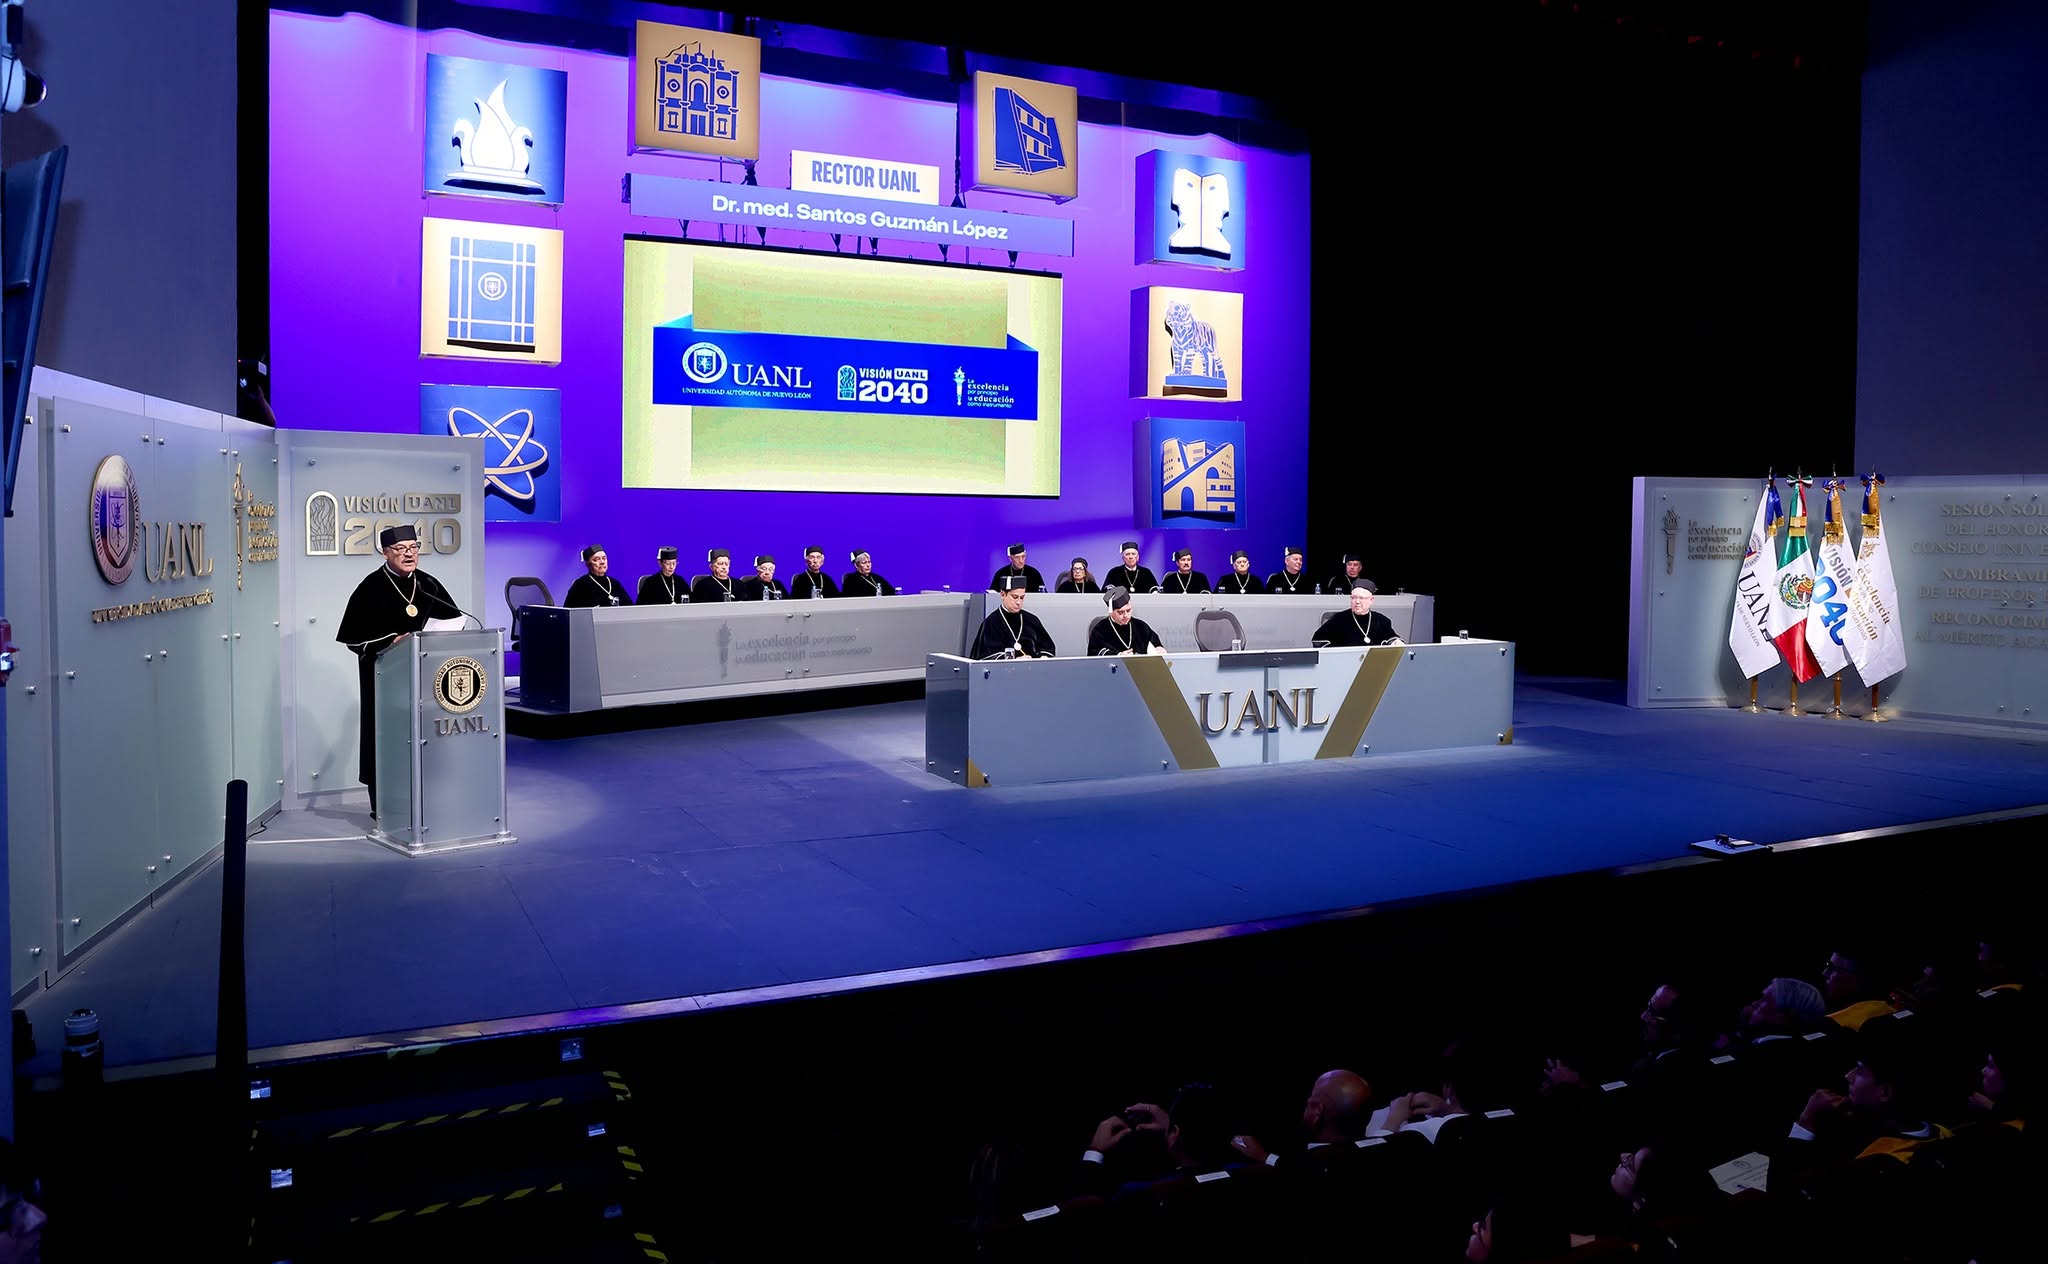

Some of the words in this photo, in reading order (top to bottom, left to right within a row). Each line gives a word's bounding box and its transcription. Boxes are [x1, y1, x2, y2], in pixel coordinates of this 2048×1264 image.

[812, 160, 874, 188] RECTOR
[878, 168, 921, 193] UANL
[712, 194, 740, 214] Dr.
[743, 201, 793, 219] med.
[796, 203, 867, 225] Santos
[870, 211, 949, 233] Guzmán
[952, 219, 1009, 240] López
[731, 363, 812, 388] UANL
[859, 367, 892, 379] VISIÓN
[895, 369, 927, 380] UANL
[682, 387, 725, 396] UNIVERSIDAD
[725, 388, 762, 398] AUTÓNOMA
[794, 391, 812, 399] LEÓN
[859, 380, 928, 404] 2040
[967, 383, 1010, 391] excelencia
[974, 395, 1015, 403] educación
[343, 492, 399, 513] VISIÓN
[408, 495, 459, 511] UANL
[1688, 525, 1742, 535] excelencia
[1944, 522, 1975, 536] DEL
[141, 521, 215, 583] UANL
[1911, 542, 1988, 554] CONSEJO
[1823, 544, 1853, 589] VISIÓN
[1857, 567, 1891, 624] excelencia
[1945, 586, 2037, 601] PROFESOR
[747, 632, 810, 649] excelencia
[1196, 686, 1331, 734] UANL
[433, 715, 490, 736] UANL
